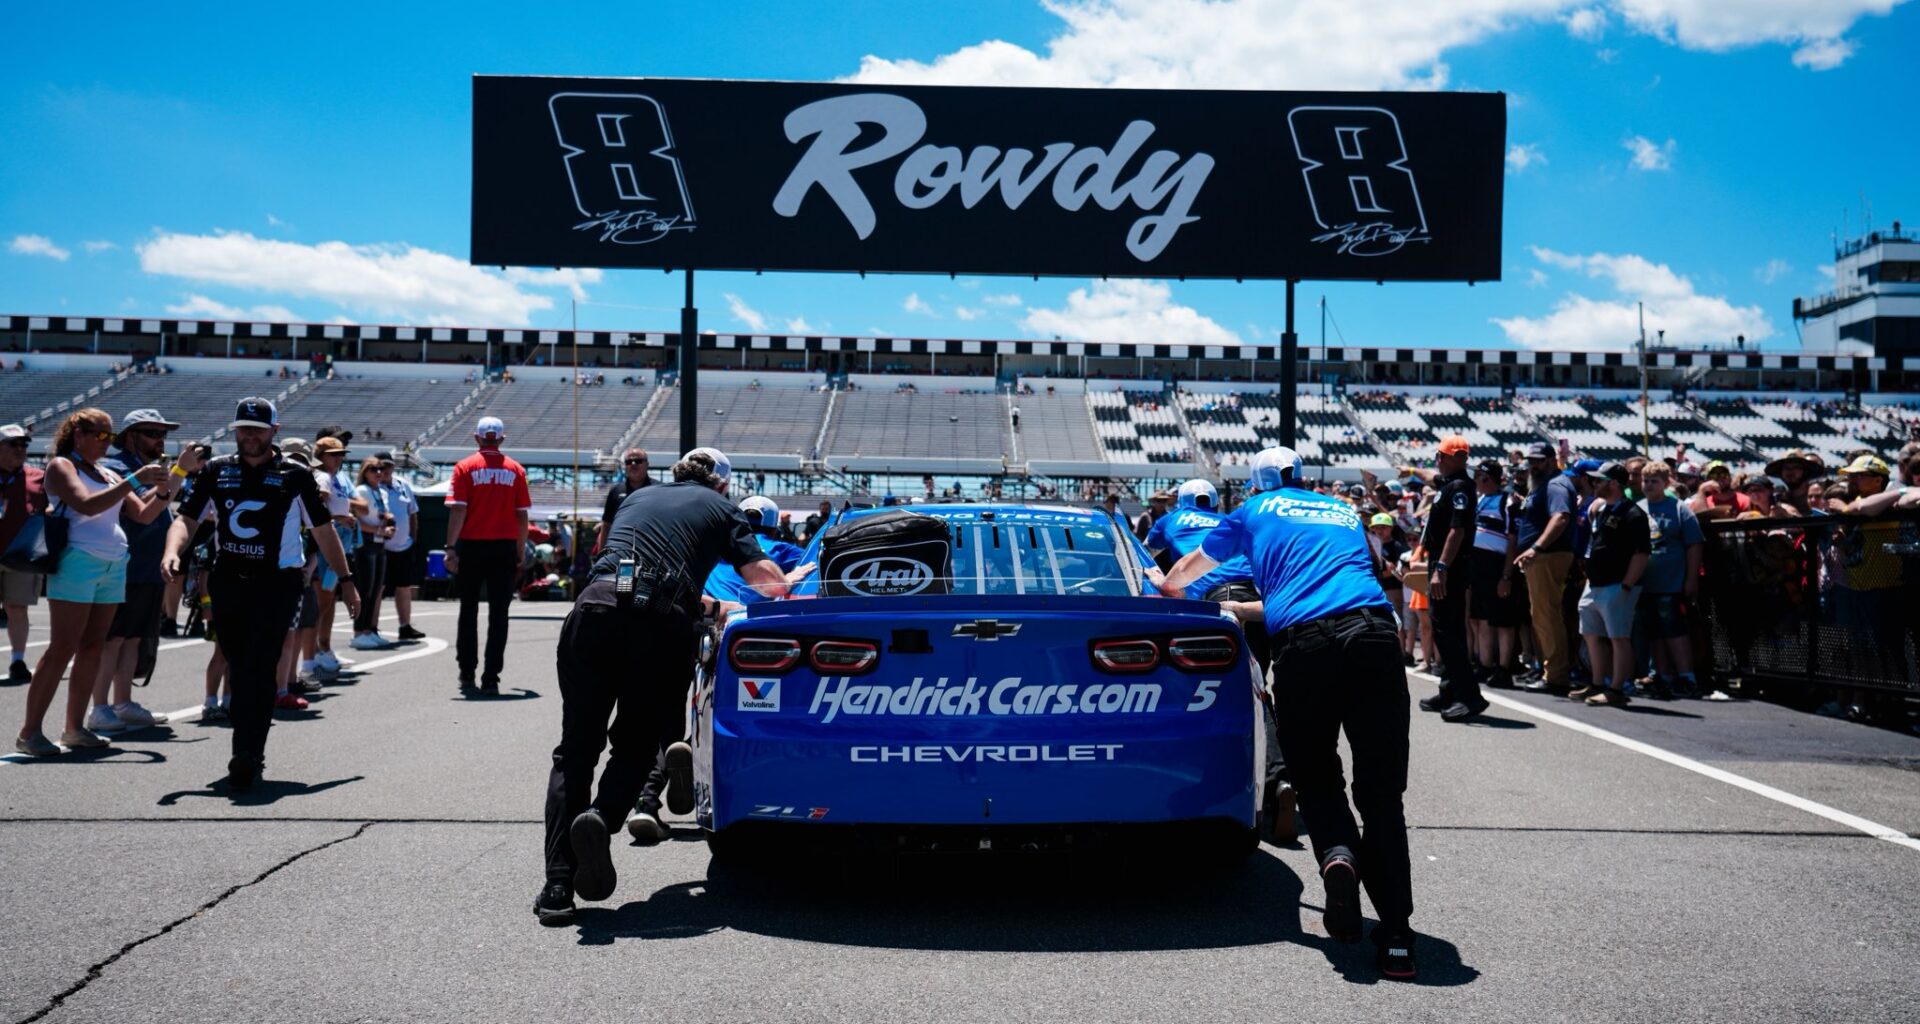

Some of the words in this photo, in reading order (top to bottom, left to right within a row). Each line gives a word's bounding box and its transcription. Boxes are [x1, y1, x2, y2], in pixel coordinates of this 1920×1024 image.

[548, 92, 694, 222] 8
[772, 93, 1215, 262] Rowdy
[1287, 105, 1428, 233] 8
[848, 560, 923, 588] Arai
[807, 676, 1163, 724] HendrickCars.com
[1186, 680, 1223, 713] 5
[850, 744, 1124, 763] CHEVROLET
